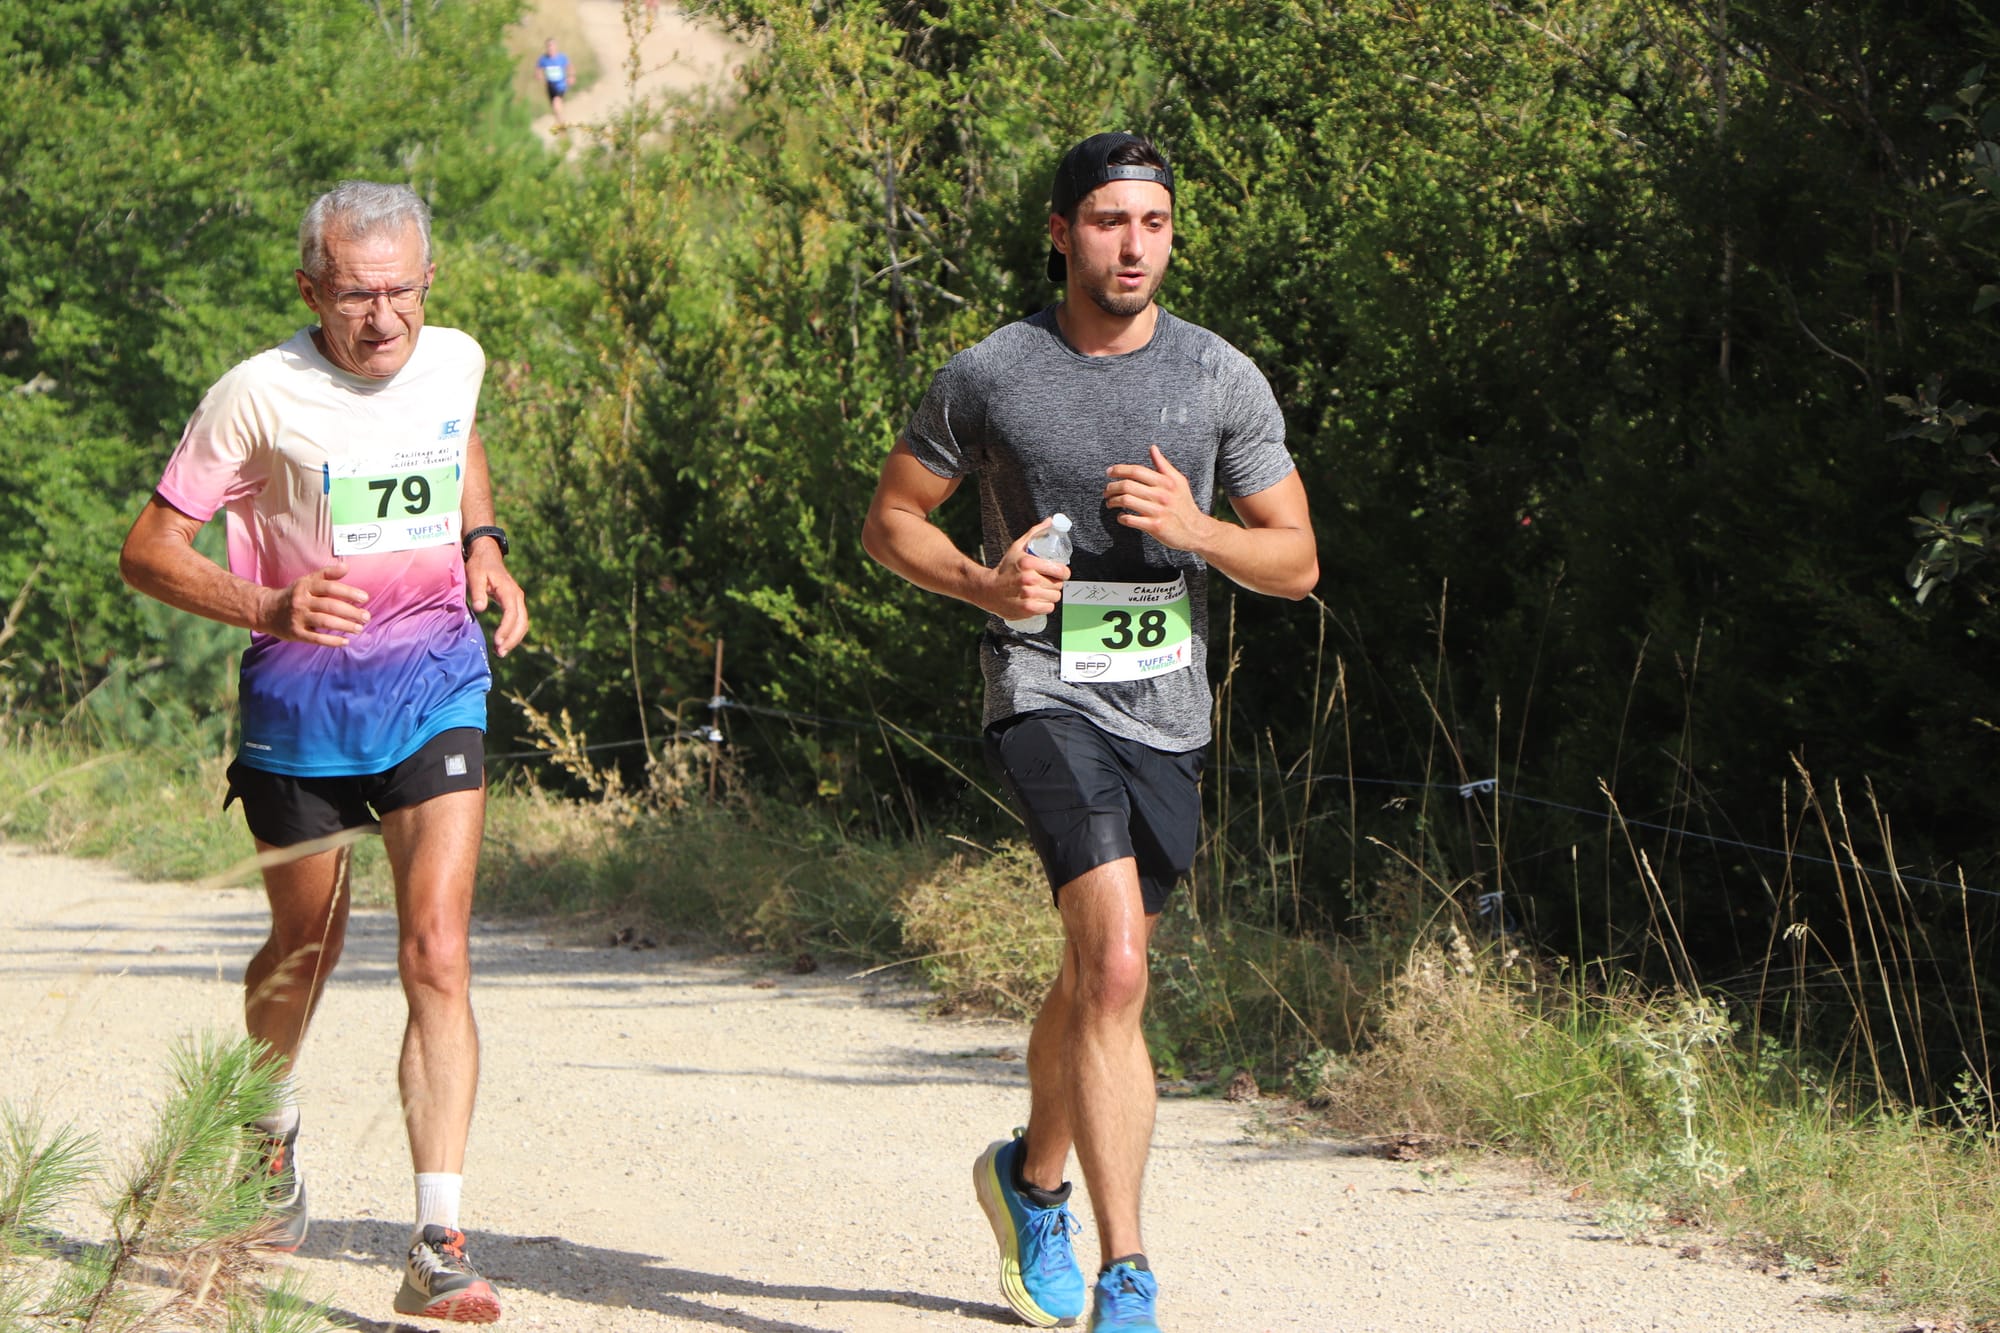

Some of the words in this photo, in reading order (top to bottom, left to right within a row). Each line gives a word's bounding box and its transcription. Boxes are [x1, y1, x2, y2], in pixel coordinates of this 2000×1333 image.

[394, 449, 434, 459] Challenge
[368, 475, 431, 518] 79
[406, 523, 442, 536] TUFF'S
[347, 532, 377, 543] BFP
[1133, 585, 1176, 595] Challenge
[1128, 594, 1160, 602] vallées
[1101, 609, 1167, 650] 38
[1075, 661, 1107, 671] BFP
[1137, 653, 1173, 668] TUFF'S
